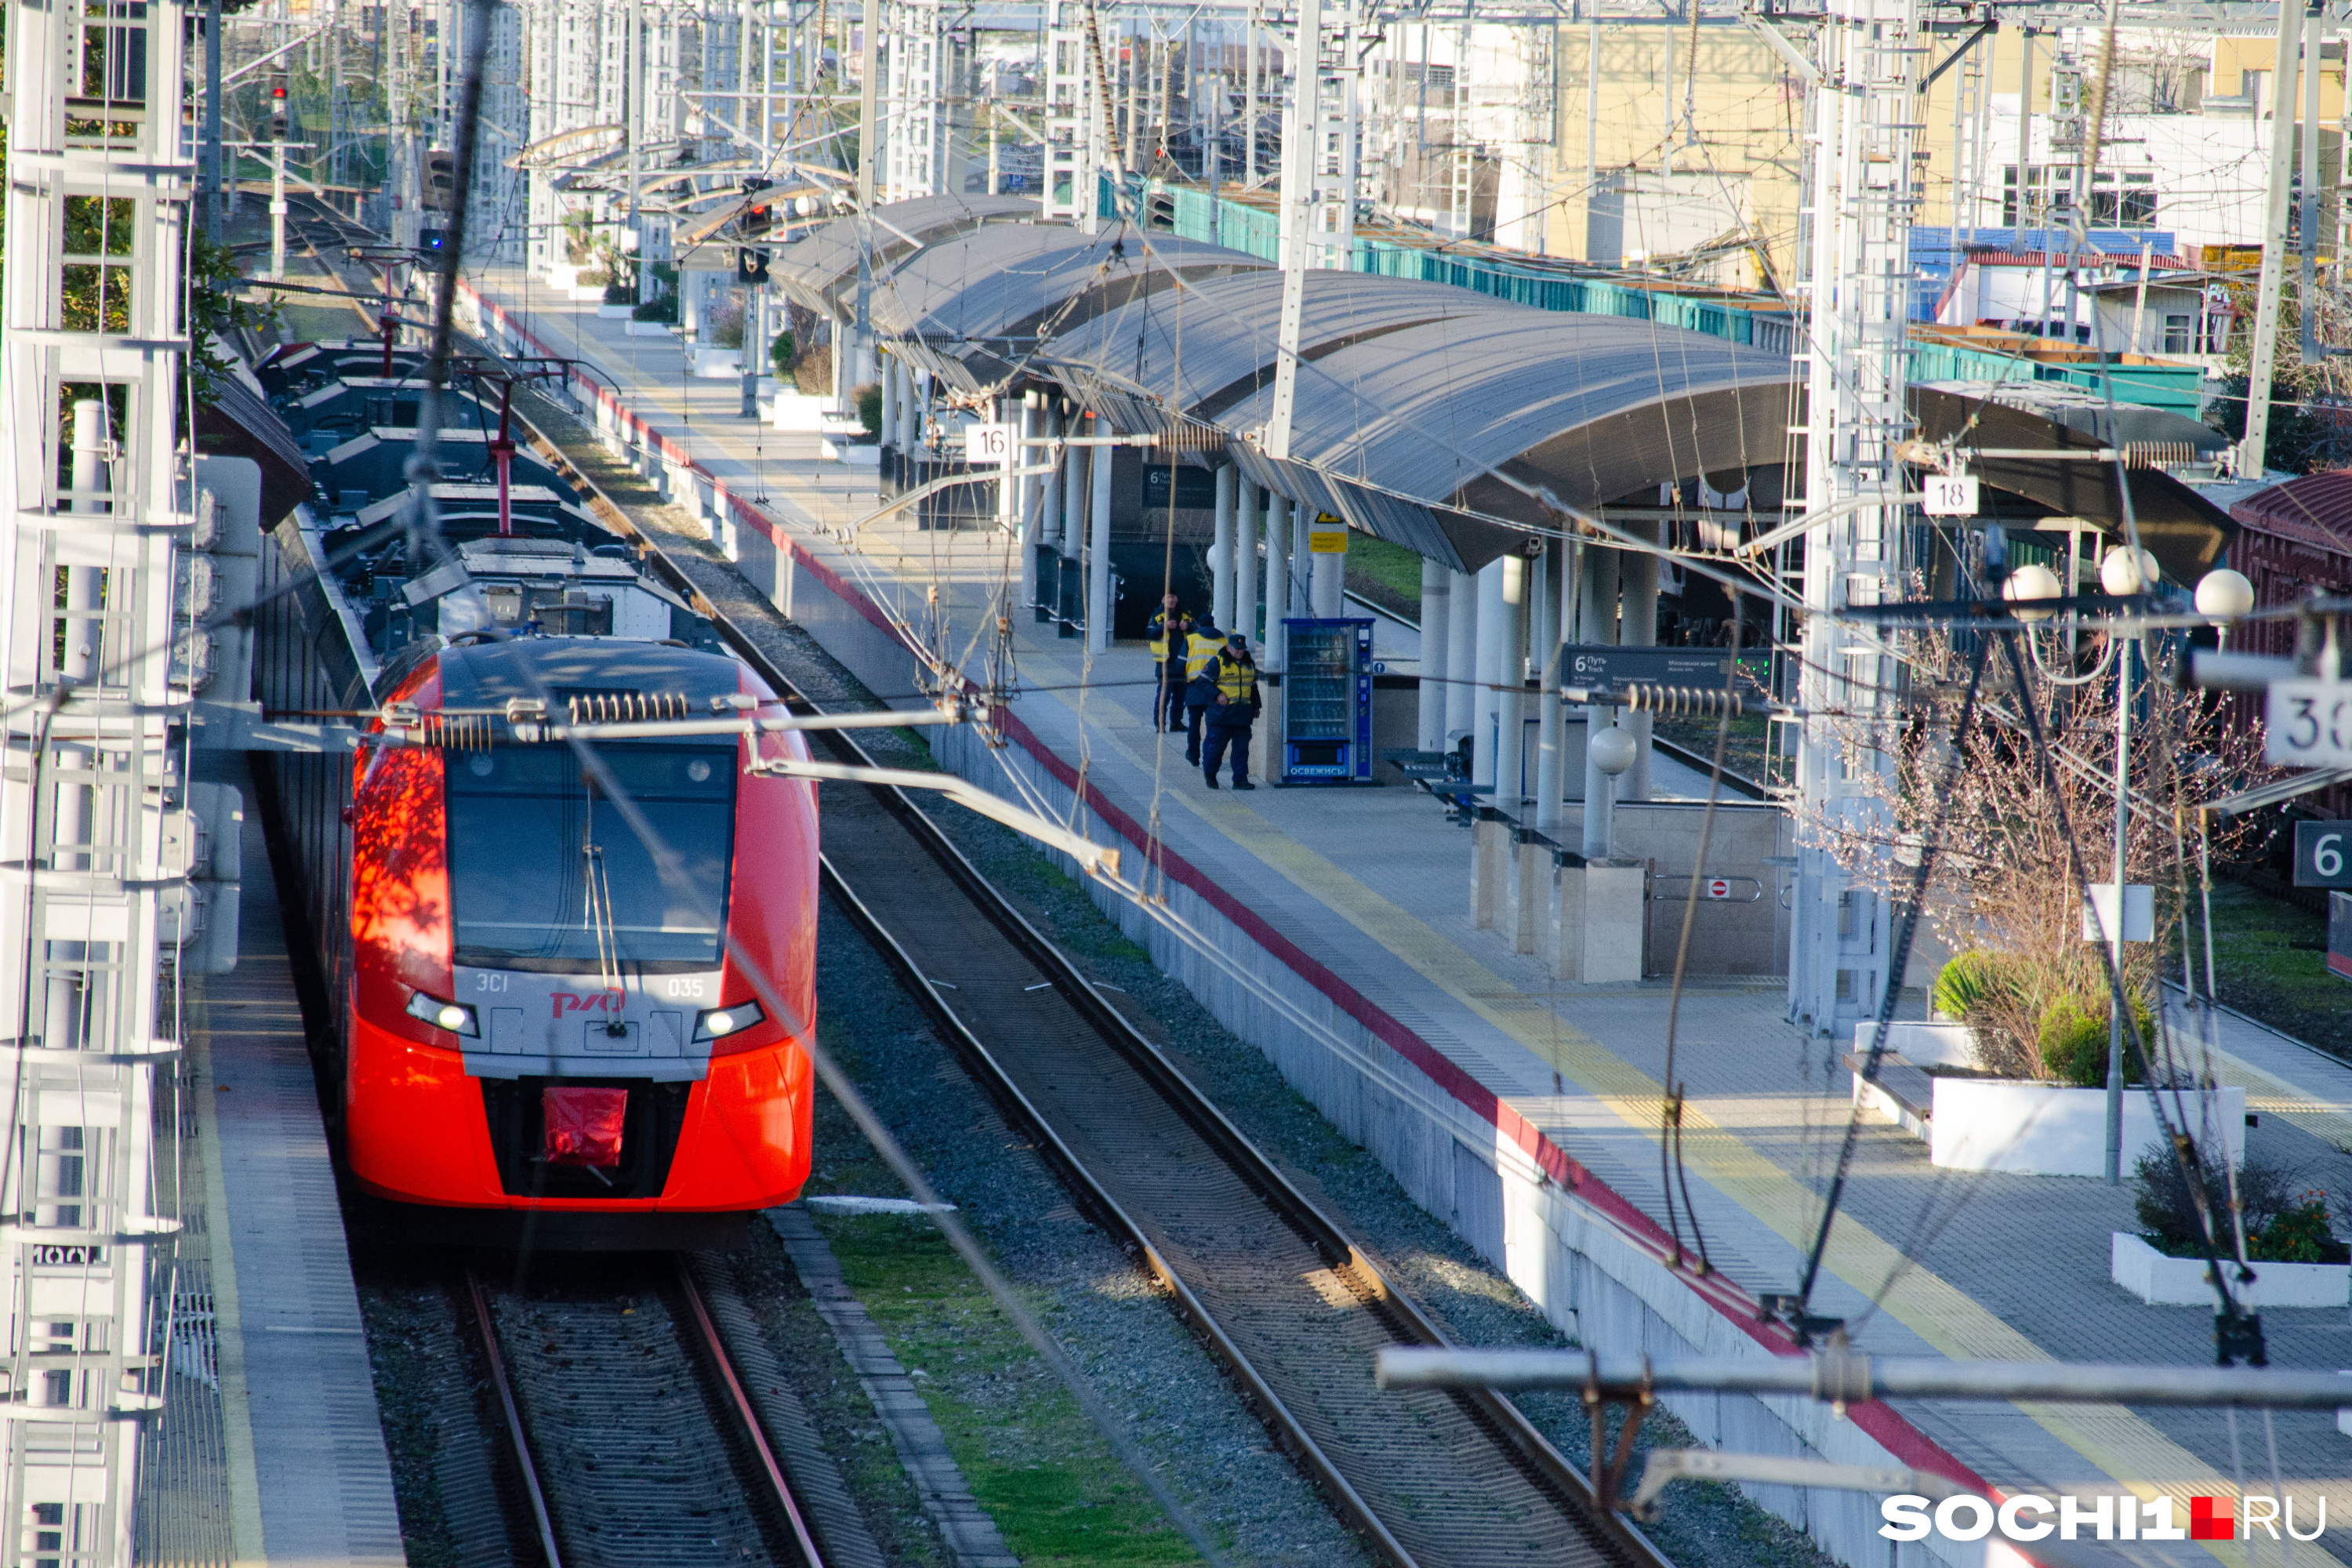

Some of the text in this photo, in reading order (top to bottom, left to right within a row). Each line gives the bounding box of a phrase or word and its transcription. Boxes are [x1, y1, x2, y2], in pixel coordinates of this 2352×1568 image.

[980, 430, 1005, 454] 16
[1150, 472, 1158, 484] 6
[1939, 483, 1964, 506] 18
[1574, 656, 1607, 672] 6 Путь
[2314, 833, 2343, 877] 6
[668, 978, 704, 997] 035
